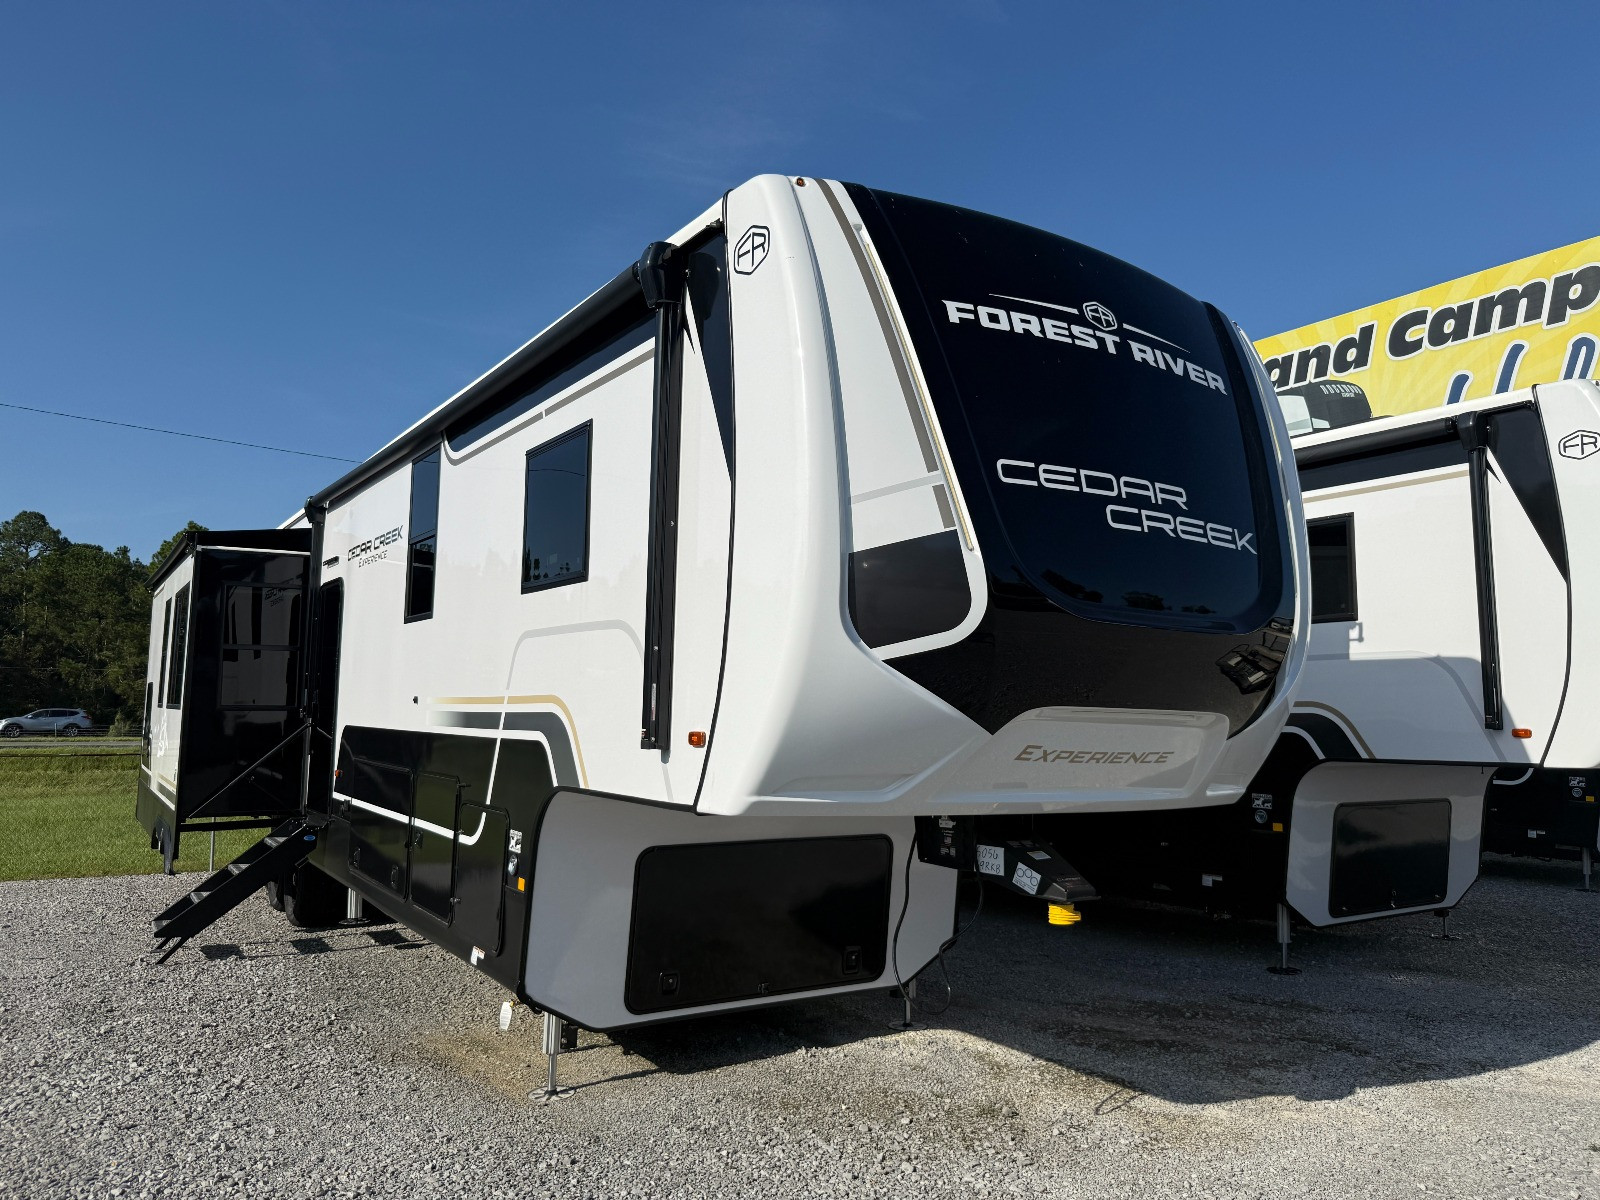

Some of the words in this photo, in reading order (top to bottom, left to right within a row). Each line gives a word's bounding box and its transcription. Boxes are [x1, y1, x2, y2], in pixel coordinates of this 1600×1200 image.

[942, 299, 1120, 355] FOREST
[1127, 340, 1228, 396] RIVER
[1264, 322, 1376, 389] and
[996, 458, 1188, 510] CEDAR
[347, 539, 373, 562] CEDAR
[373, 525, 404, 550] CREEK
[1105, 504, 1257, 555] CREEK
[358, 549, 388, 568] EXPERIENCE
